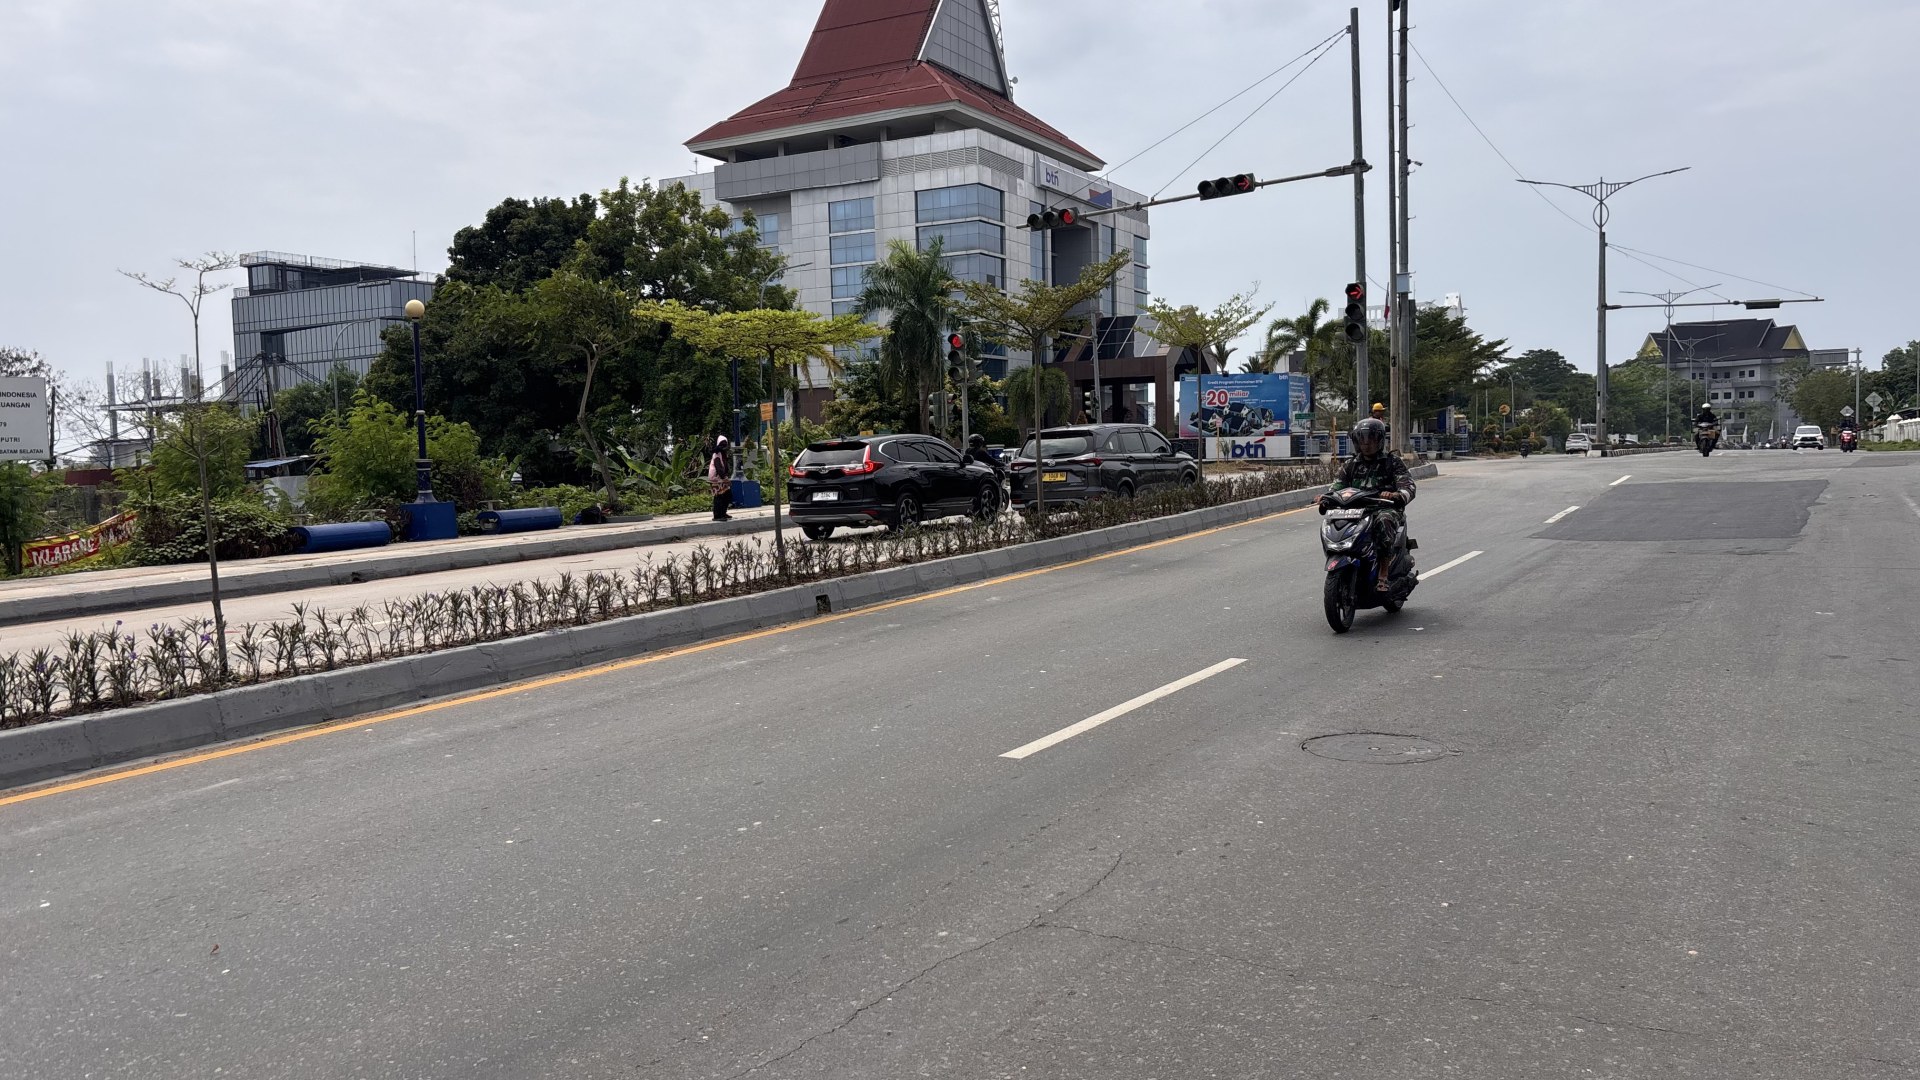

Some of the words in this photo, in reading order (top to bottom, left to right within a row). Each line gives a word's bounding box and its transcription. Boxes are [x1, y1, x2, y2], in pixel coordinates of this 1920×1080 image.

[1045, 168, 1059, 186] btn
[1206, 389, 1229, 406] 20
[1229, 390, 1249, 398] miliar
[1231, 438, 1266, 458] btn
